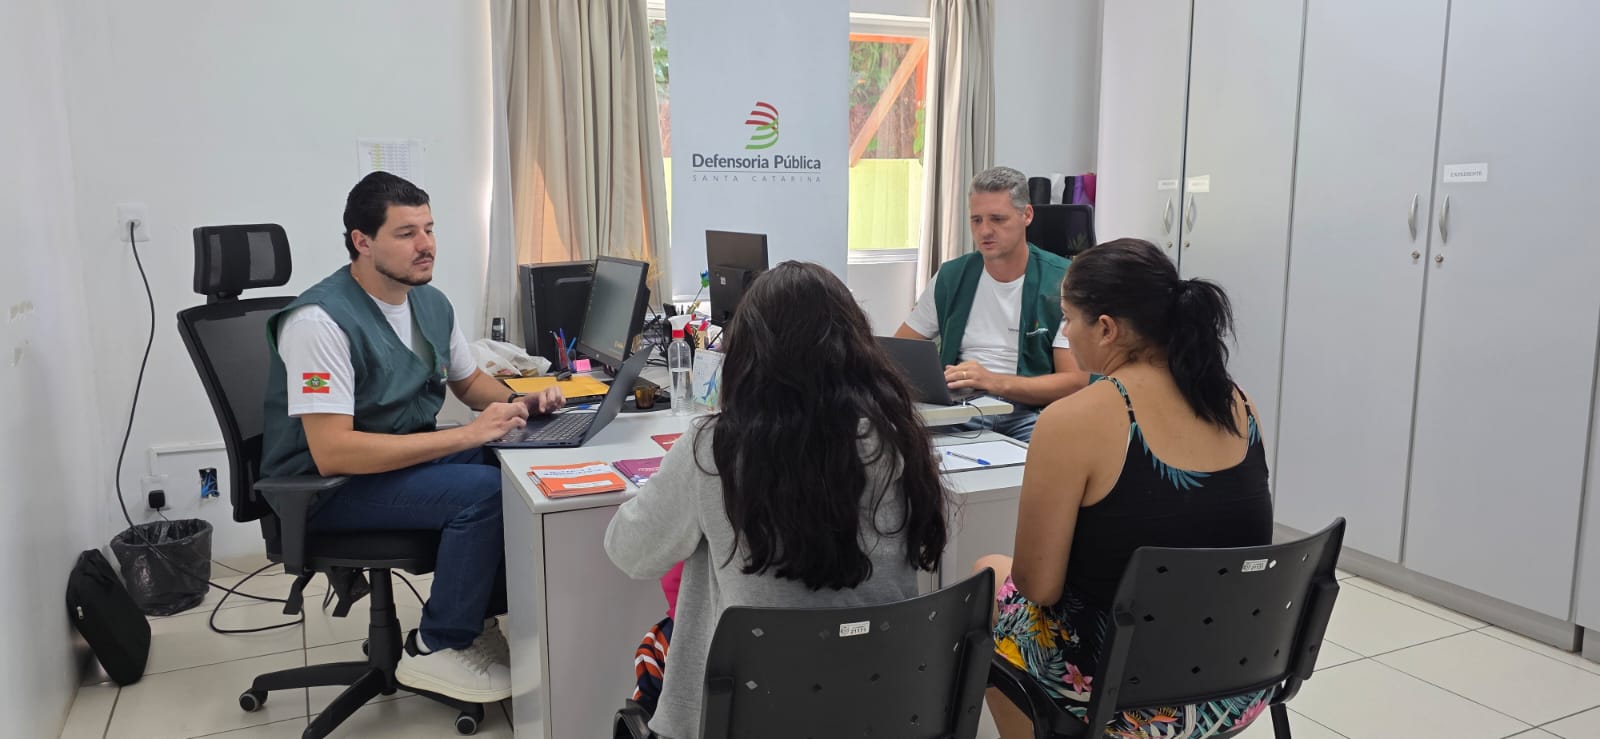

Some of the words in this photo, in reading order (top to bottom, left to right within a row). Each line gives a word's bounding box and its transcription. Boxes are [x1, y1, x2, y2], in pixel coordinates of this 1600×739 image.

[692, 153, 769, 169] Defensoria
[774, 154, 821, 169] Pública
[692, 174, 739, 182] SANTA
[751, 175, 821, 183] CATARINA
